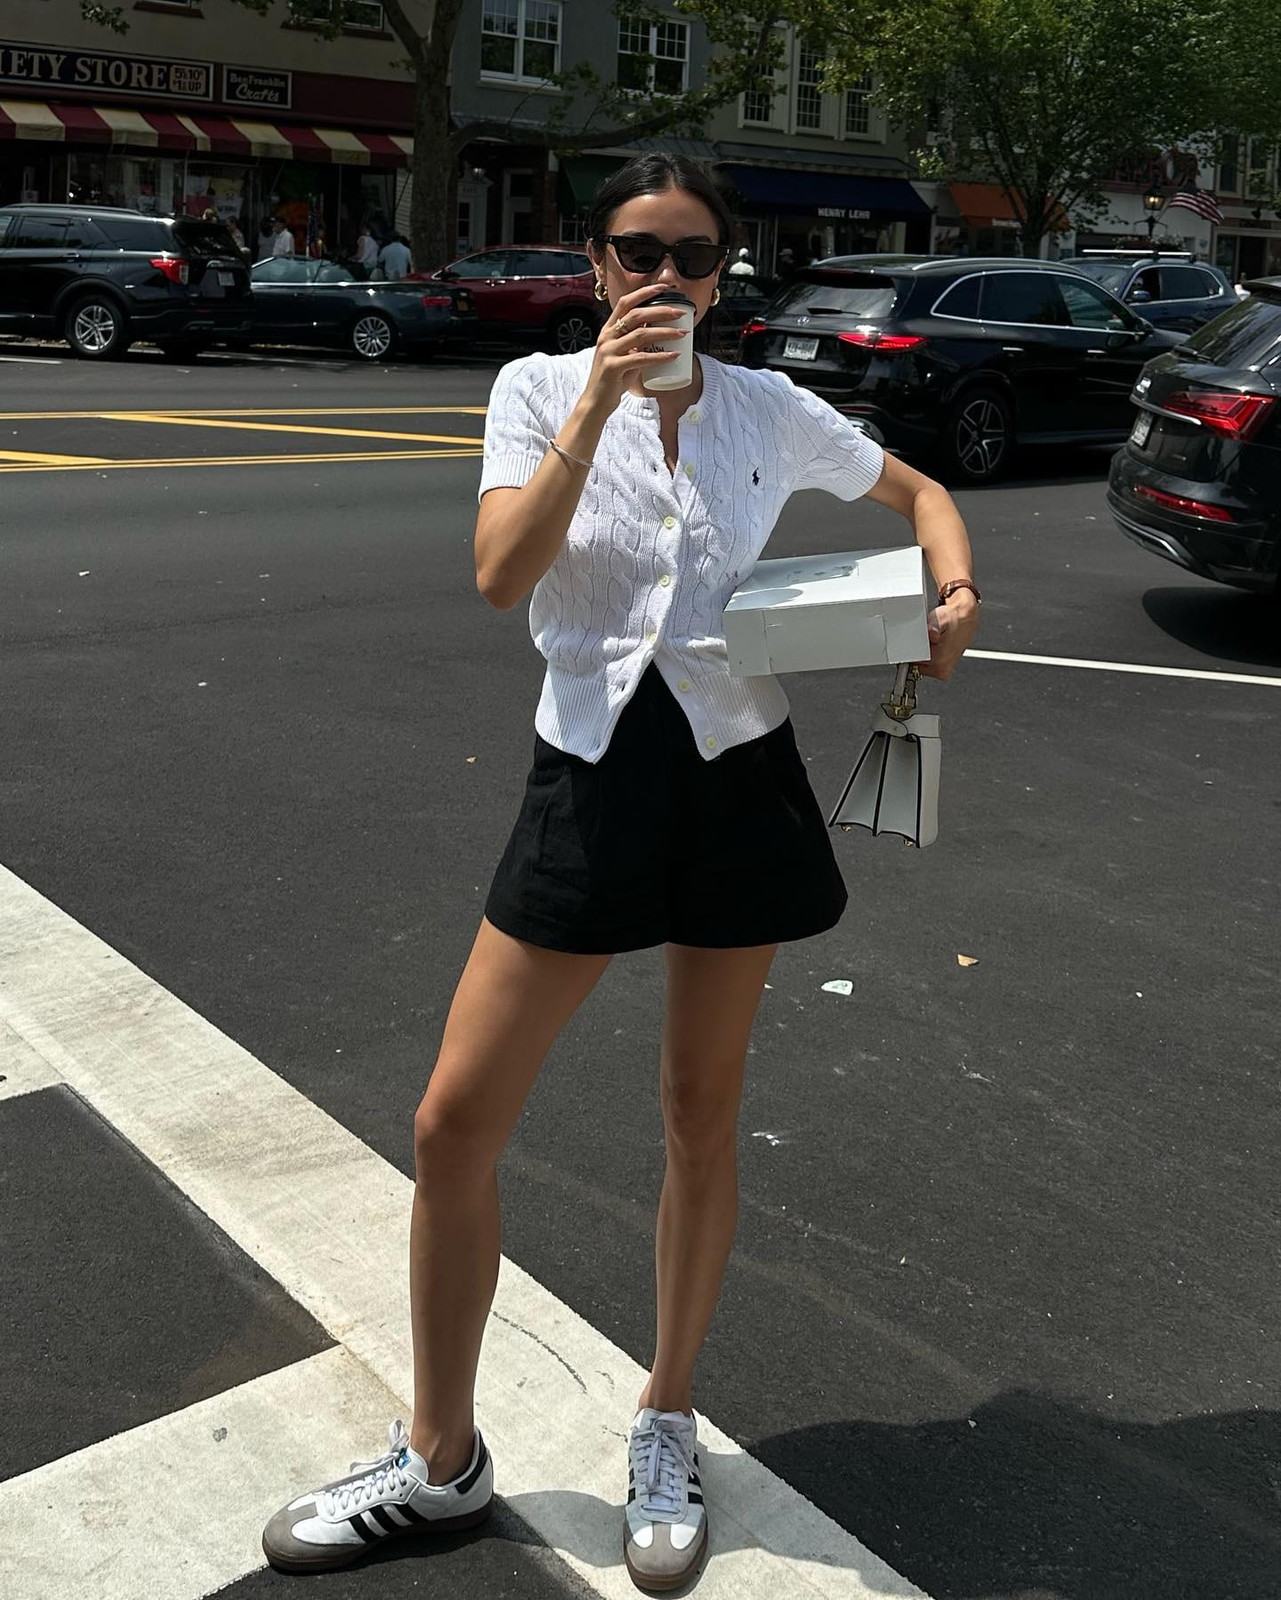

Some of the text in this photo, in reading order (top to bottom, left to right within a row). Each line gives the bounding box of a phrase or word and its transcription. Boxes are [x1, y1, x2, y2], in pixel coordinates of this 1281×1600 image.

[74, 56, 168, 90] STORE
[188, 80, 202, 92] UP
[235, 83, 280, 102] Crafts
[817, 207, 871, 220] HENRY LEHR
